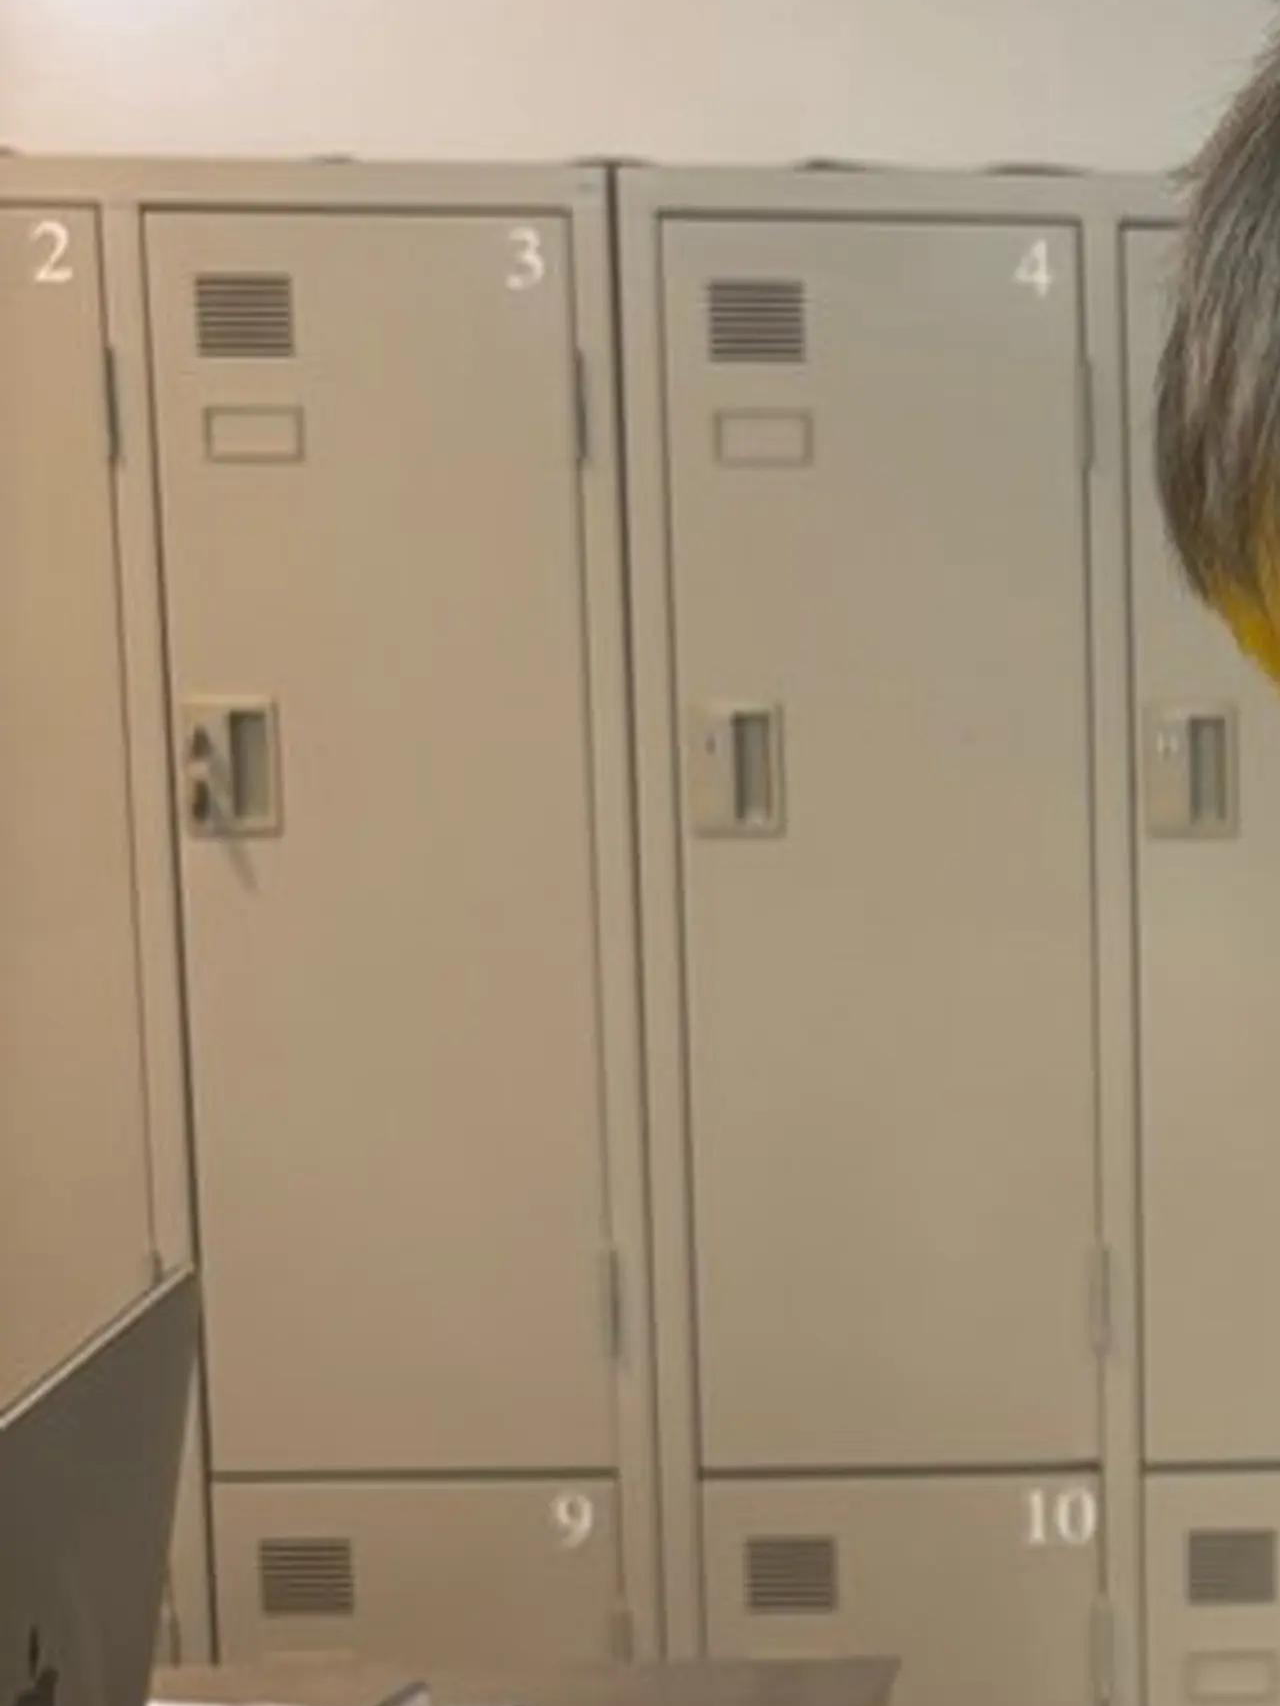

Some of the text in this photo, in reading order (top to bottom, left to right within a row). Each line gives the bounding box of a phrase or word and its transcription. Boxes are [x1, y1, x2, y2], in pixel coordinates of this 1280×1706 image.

[32, 220, 73, 284] 2
[505, 226, 546, 289] 3
[1014, 238, 1053, 297] 4
[554, 1494, 594, 1548] 9
[1024, 1489, 1097, 1546] 10
